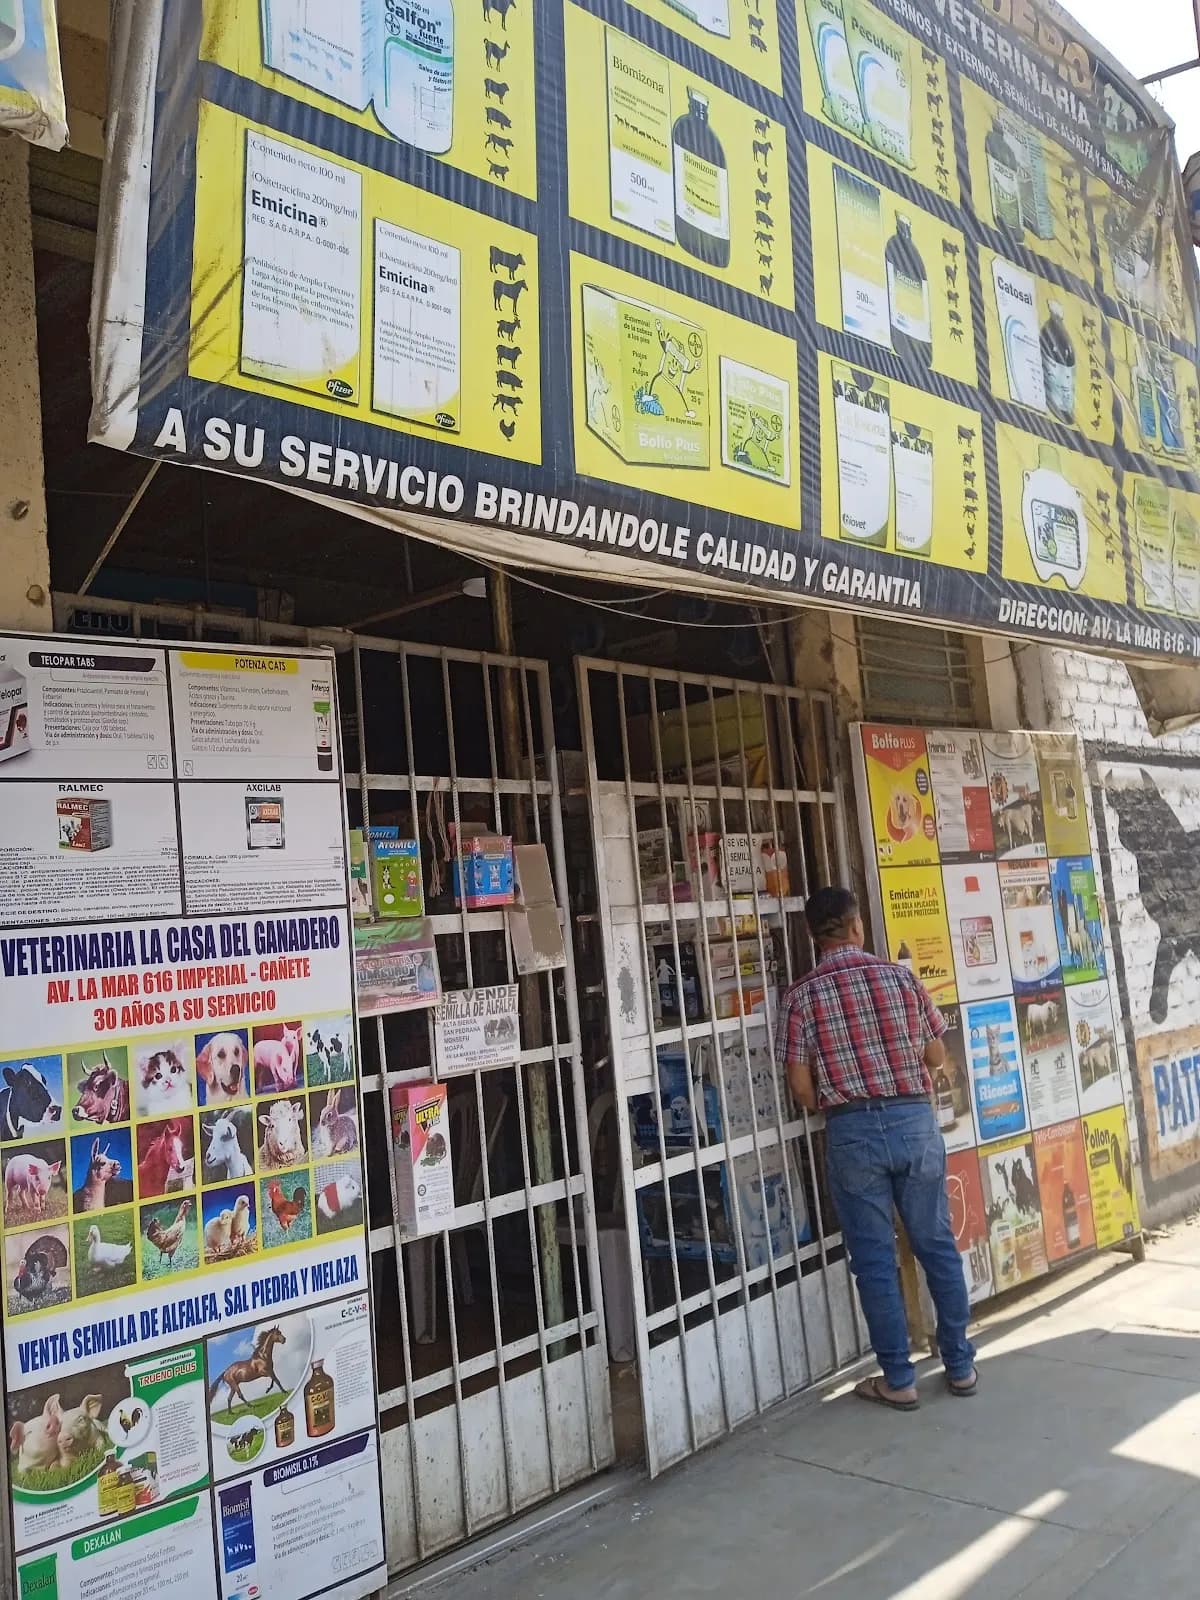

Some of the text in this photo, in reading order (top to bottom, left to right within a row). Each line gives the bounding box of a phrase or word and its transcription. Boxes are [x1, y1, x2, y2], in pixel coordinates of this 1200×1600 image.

[419, 29, 444, 45] fuerte
[612, 55, 665, 95] Biomizona
[630, 172, 648, 189] 500
[251, 189, 329, 228] Emicina®
[856, 290, 869, 305] 500
[996, 276, 1034, 307] Catosal
[153, 406, 922, 608] A SU SERVICIO BRINDANDOLE CALIDAD Y GARANTIA
[998, 596, 1089, 636] DIRECCION:
[1090, 615, 1113, 640] AV.
[1115, 620, 1132, 645] LA
[1134, 623, 1161, 650] MAR
[1163, 631, 1185, 654] 616
[40, 655, 96, 668] TELOPAR TABS
[234, 658, 287, 672] POTENZA CATS
[871, 732, 916, 749] Bolfo PLUS
[58, 784, 104, 792] RALMEC
[246, 784, 282, 792] AXCILAB
[727, 838, 735, 847] SE
[0, 915, 340, 977] VETERINARIA LA CASA DEL GANADERO
[47, 979, 74, 1004] AV.
[77, 977, 99, 1002] LA
[101, 972, 139, 997] MAR
[143, 970, 173, 996] 616
[177, 962, 248, 990] IMPERIAL
[259, 956, 311, 982] CAÑETE
[441, 992, 458, 1004] SE
[462, 985, 517, 1002] VENDE
[93, 989, 276, 1031] 30 AÑOS A SU SERVICIO
[436, 998, 517, 1021] SEMILLA DE ALFALFA
[415, 1107, 441, 1125] ULTRA
[1083, 1120, 1110, 1151] Pollon
[18, 1254, 360, 1374] VENTA SEMILLA DE ALFALFA, SAL PIEDRA Y MELAZA
[137, 1361, 197, 1387] TRUENO PLUS
[273, 1455, 319, 1481] BIOMISIL 0.1%
[222, 1497, 250, 1518] Biomisil
[83, 1528, 122, 1553] DEXALAN
[22, 1572, 57, 1594] Dexalan
[79, 1566, 115, 1589] Componentes:
